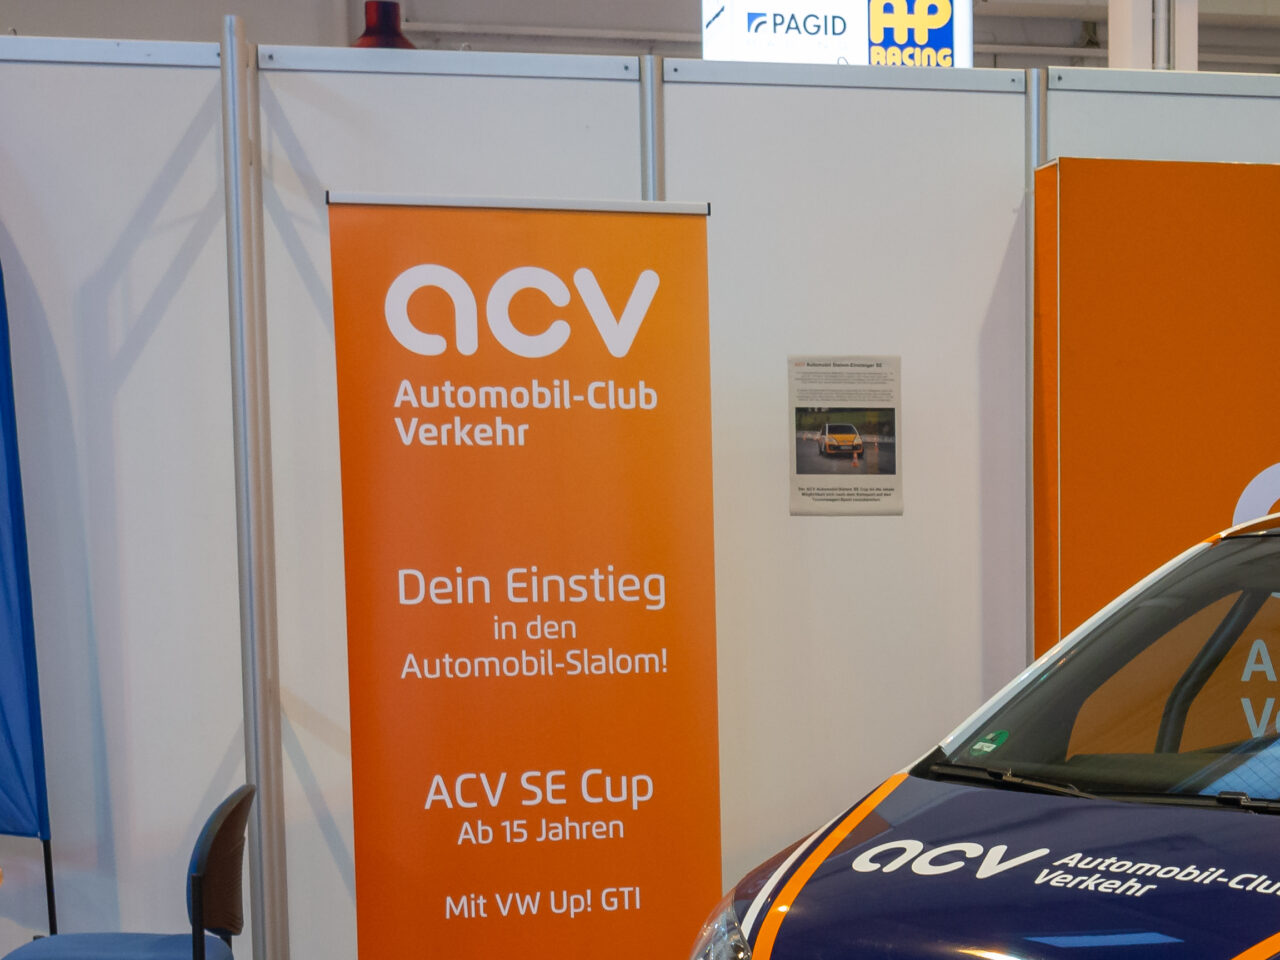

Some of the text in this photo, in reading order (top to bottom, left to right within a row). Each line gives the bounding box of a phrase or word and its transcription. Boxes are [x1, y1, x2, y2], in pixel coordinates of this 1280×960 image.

[773, 13, 847, 36] PAGID
[869, 0, 952, 45] AP
[870, 45, 953, 67] RACING
[385, 264, 660, 358] acv
[394, 379, 658, 410] Automobil-Club
[394, 416, 529, 446] Verkehr
[398, 565, 666, 610] Dein Einstieg
[493, 615, 577, 640] in den
[401, 648, 667, 679] Automobil-Slalom!
[424, 769, 653, 810] ACV SE Cup
[457, 817, 624, 845] Ab 15 Jahren
[852, 839, 1050, 880] acv
[1034, 868, 1158, 897] Verkehr
[445, 886, 641, 919] Mit VW Up! GTI
